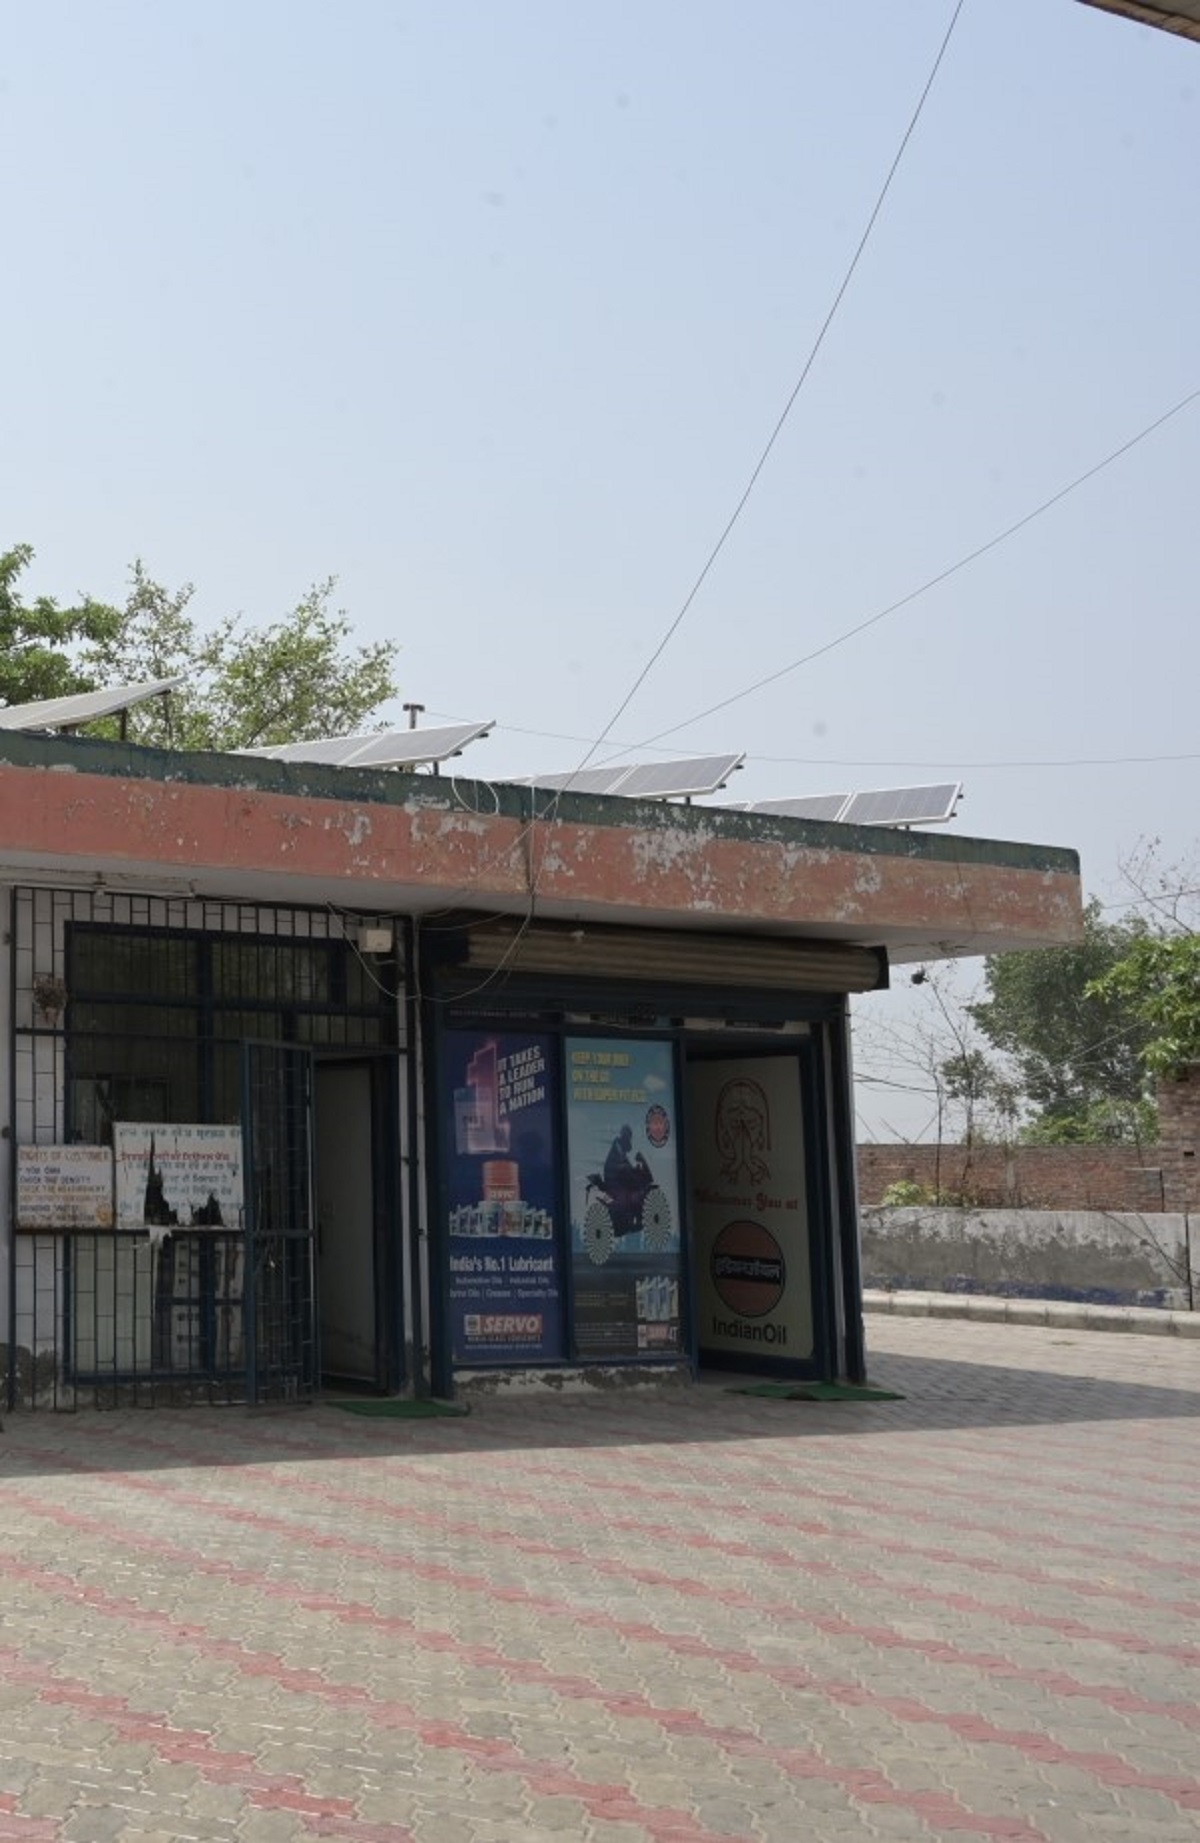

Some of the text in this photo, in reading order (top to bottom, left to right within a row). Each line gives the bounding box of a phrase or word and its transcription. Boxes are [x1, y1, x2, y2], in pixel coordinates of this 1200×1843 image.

[509, 1045, 541, 1068] TAKES
[499, 1058, 545, 1086] A LEADER
[500, 1075, 535, 1101] TO RUN
[500, 1086, 545, 1115] A NATION
[450, 1256, 553, 1272] India's No.1 Lubricant
[484, 1316, 539, 1333] SERVO
[712, 1316, 787, 1345] IndianOil
